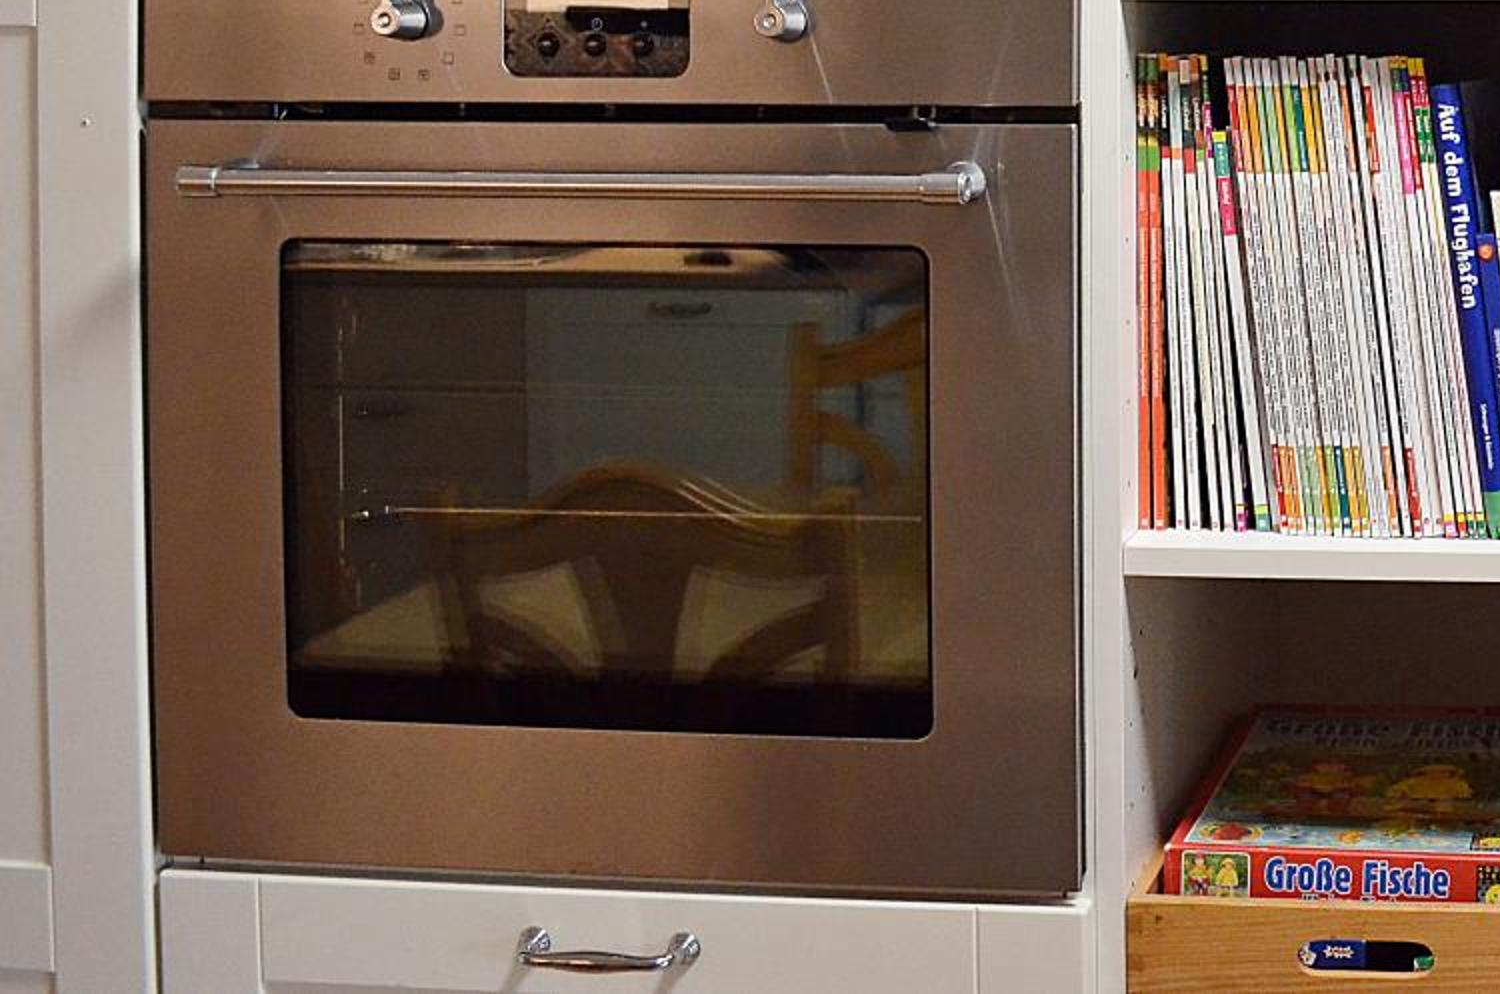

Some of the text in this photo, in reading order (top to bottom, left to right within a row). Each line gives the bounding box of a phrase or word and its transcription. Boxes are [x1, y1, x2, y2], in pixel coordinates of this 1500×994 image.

[1437, 101, 1481, 309] Auf dem Flughafen
[1265, 856, 1450, 899] Große Fische
